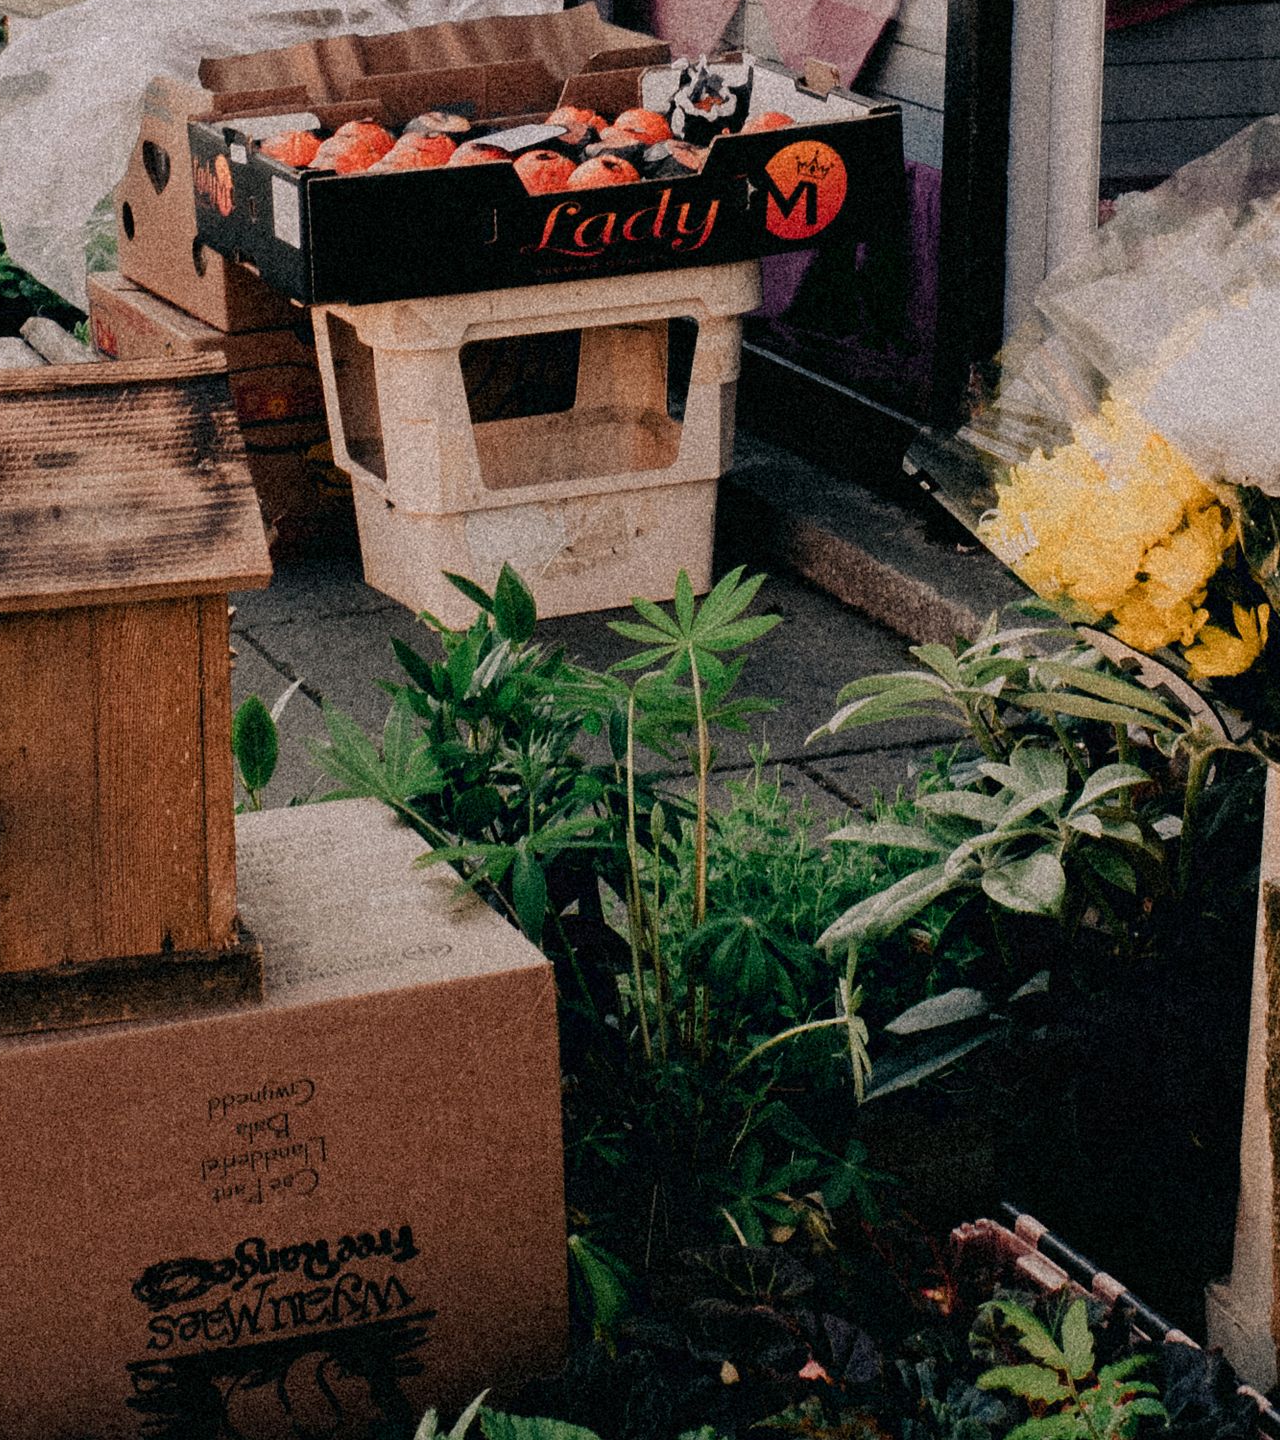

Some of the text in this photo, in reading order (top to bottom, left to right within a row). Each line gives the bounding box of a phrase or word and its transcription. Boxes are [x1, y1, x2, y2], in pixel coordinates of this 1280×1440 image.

[519, 188, 720, 258] Lady
[211, 1225, 419, 1292] Free Range
